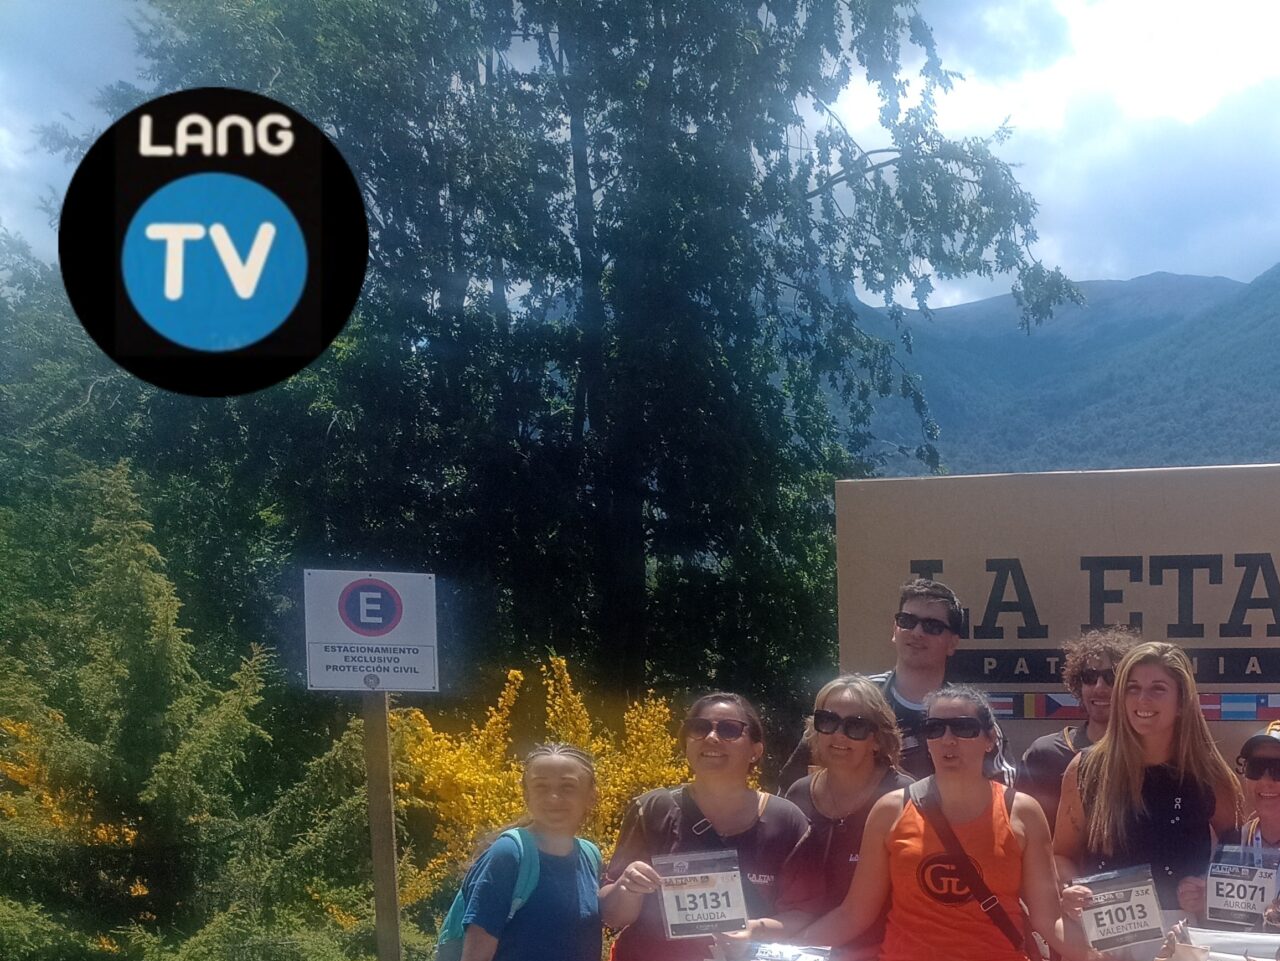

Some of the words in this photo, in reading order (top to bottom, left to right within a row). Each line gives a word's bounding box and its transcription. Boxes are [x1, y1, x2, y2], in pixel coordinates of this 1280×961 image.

[324, 645, 419, 655] ESTACIONAMIENTO
[344, 655, 400, 664] EXCLUSIVO
[983, 656, 1263, 676] PATIA
[325, 664, 390, 673] PROTECCIÓN
[393, 666, 420, 674] CIVIL
[1215, 881, 1266, 903] E2071
[675, 890, 732, 912] L3131
[1223, 900, 1257, 912] AURORA
[685, 911, 727, 922] CLAUDIA
[1094, 903, 1148, 928] E1013
[1099, 920, 1150, 936] VALENTINA
